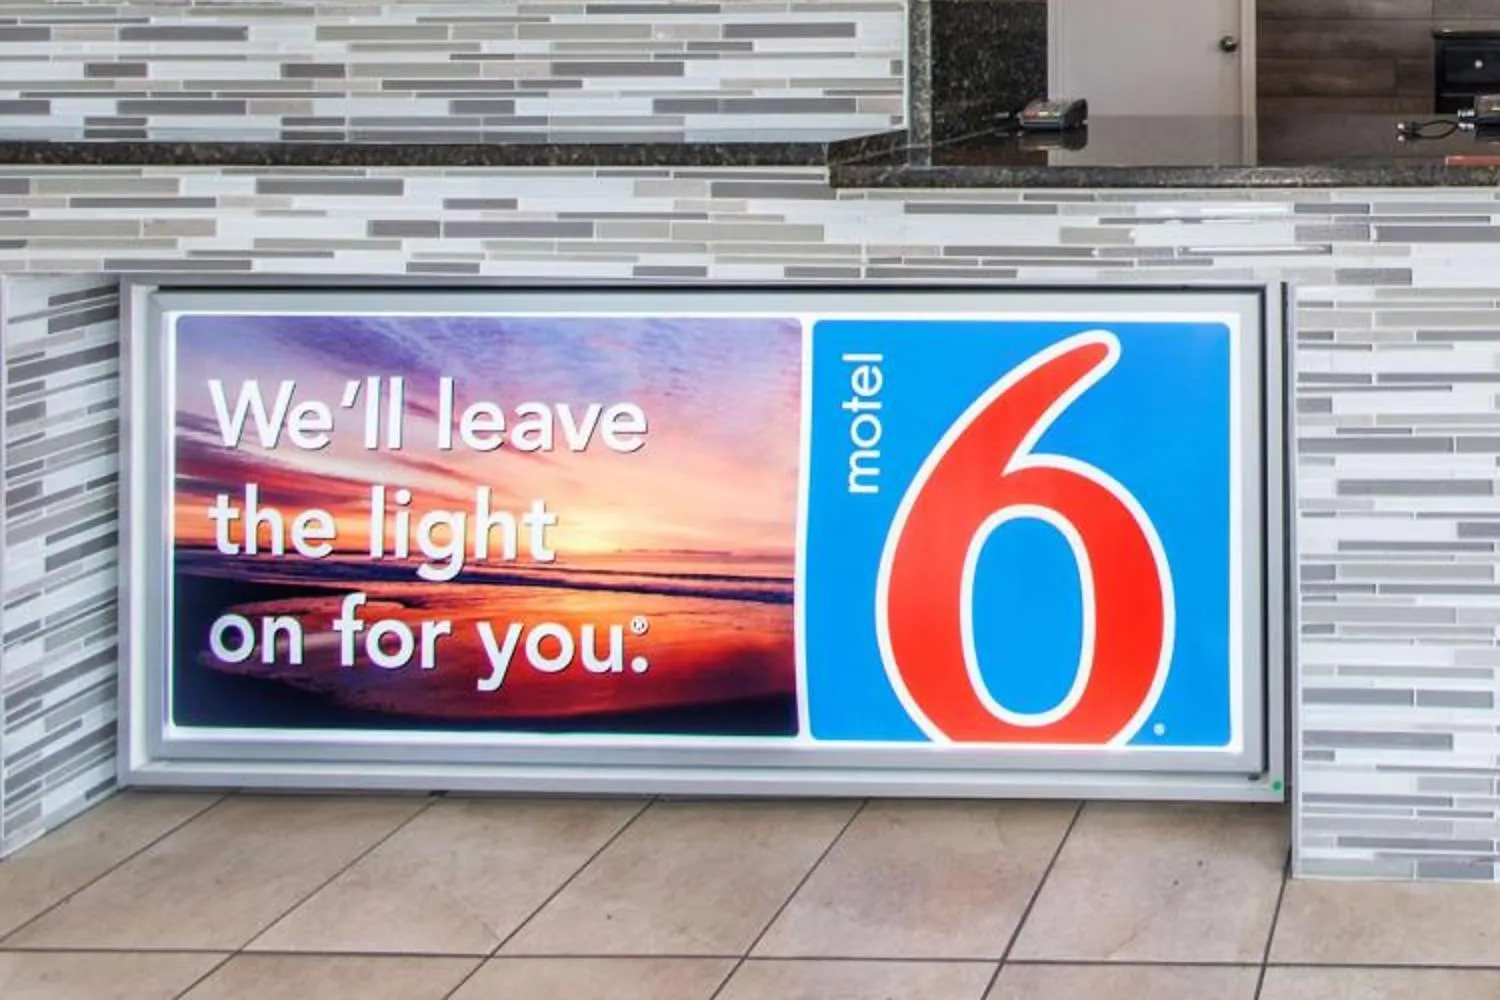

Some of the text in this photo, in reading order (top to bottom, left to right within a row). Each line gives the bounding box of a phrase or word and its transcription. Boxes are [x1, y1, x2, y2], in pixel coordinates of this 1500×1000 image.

[207, 375, 649, 453] We’ll leave
[208, 482, 559, 582] the light
[841, 328, 1178, 748] motel 6
[208, 612, 304, 666] on
[332, 592, 451, 671] for
